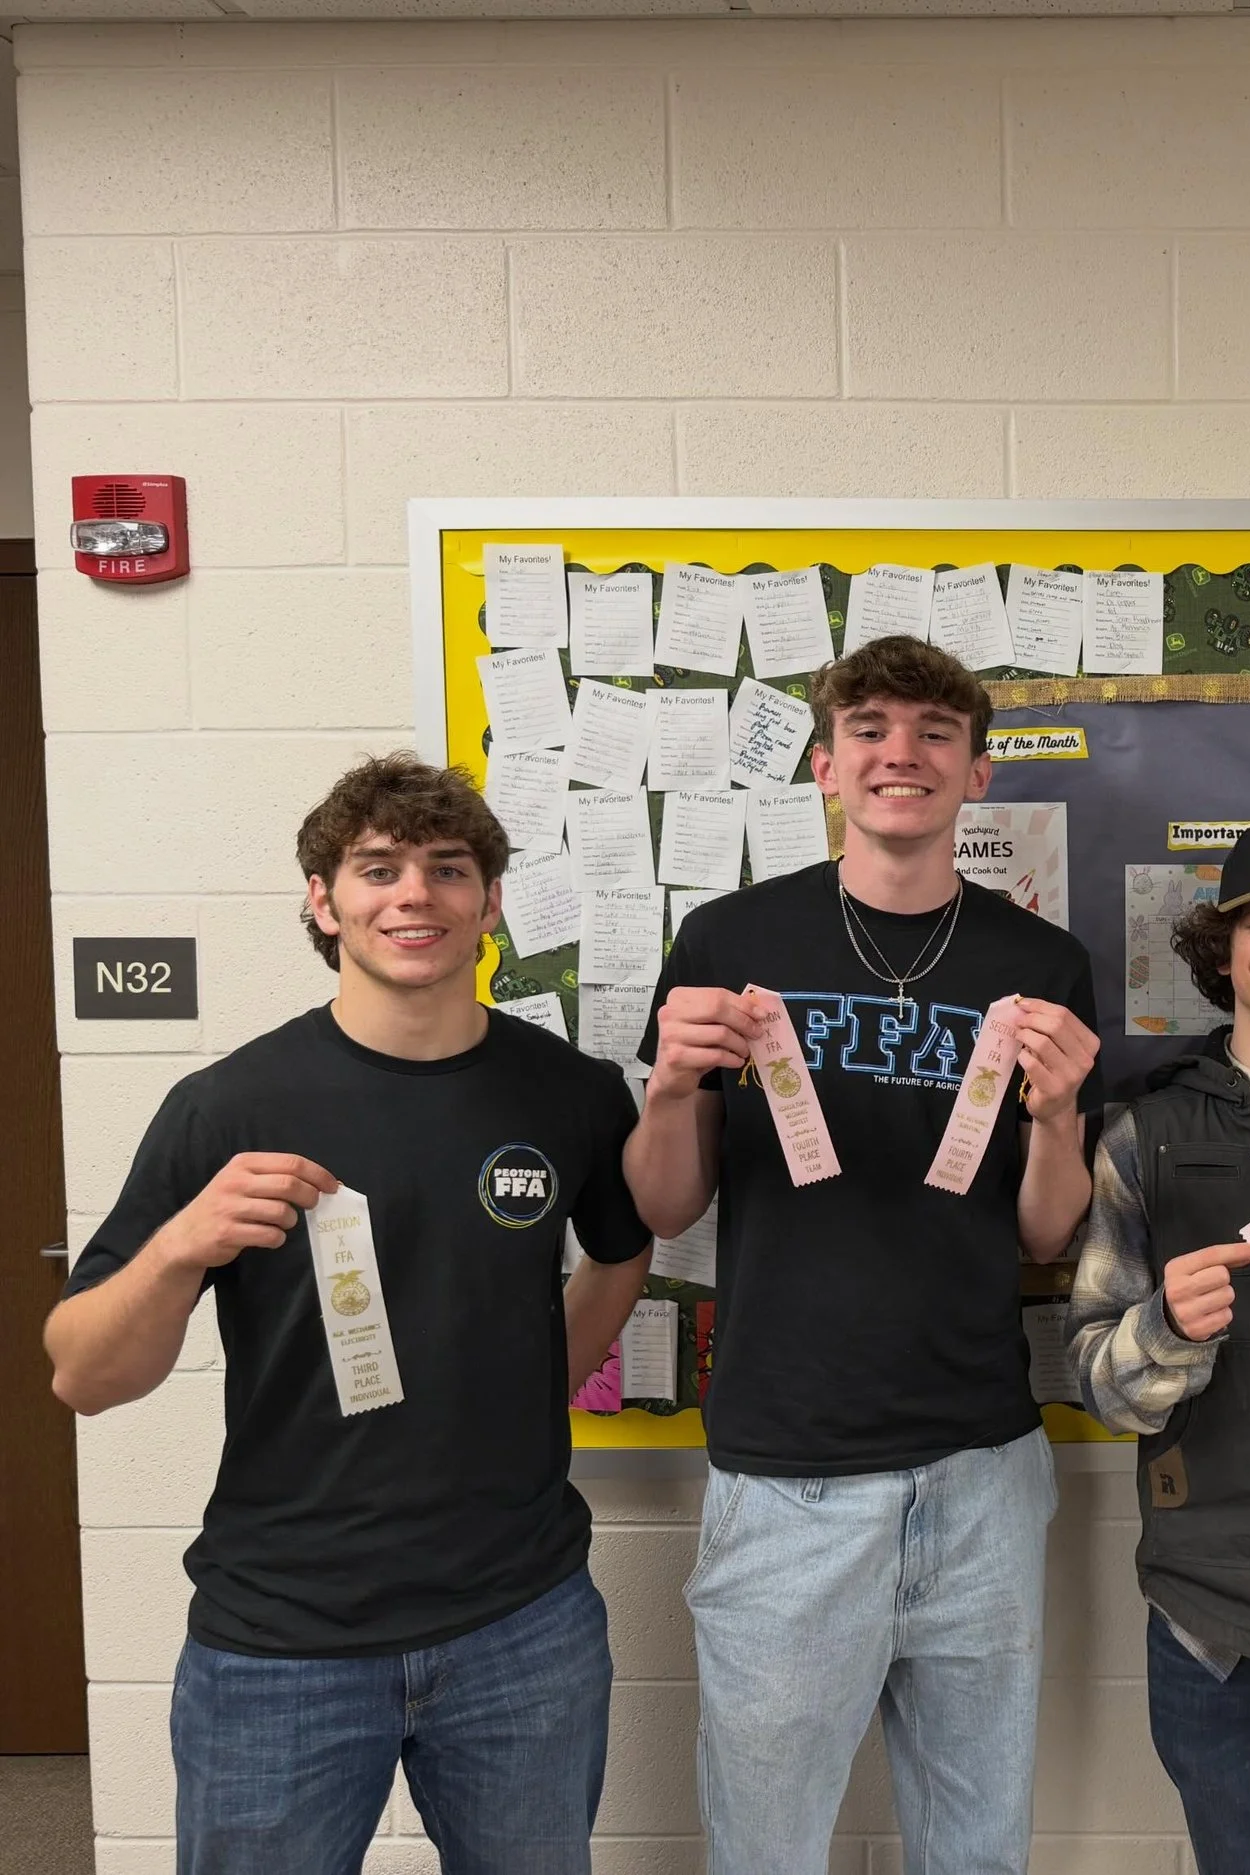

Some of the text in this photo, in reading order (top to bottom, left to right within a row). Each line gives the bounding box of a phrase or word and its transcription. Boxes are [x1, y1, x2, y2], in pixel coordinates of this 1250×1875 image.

[499, 555, 551, 565] My Favorites!
[98, 560, 147, 574] FIRE
[678, 571, 735, 588] My Favorites!
[867, 567, 923, 583] My Favorites!
[584, 584, 640, 594] My Favorites!
[752, 575, 808, 591] My Favorites!
[933, 575, 986, 593] My Favorites!
[1023, 577, 1078, 593] My Favorites!
[1096, 577, 1151, 588] My Favorites!
[491, 652, 546, 671] My Favorites!
[591, 689, 647, 710] My Favorites!
[660, 696, 715, 705] My Favorites!
[754, 688, 808, 716] My Favorites!
[997, 737, 1011, 755] of
[1013, 736, 1035, 749] the
[1037, 735, 1079, 750] Month
[578, 794, 634, 806] My Favorites!
[679, 792, 734, 805] My Favorites!
[759, 794, 812, 808] My Favorites!
[962, 826, 1000, 837] Backyard
[972, 866, 992, 875] Cook
[993, 866, 1008, 874] Out
[596, 890, 651, 900] My Favorites!
[96, 961, 172, 994] N32
[593, 985, 649, 995] My Favorites!
[509, 1000, 549, 1015] Favorites!
[764, 1029, 772, 1039] X
[780, 990, 984, 1081] FFA
[766, 1042, 783, 1054] FFA
[996, 1038, 1004, 1047] X
[987, 1051, 1002, 1064] FFA
[873, 1075, 935, 1087] THE FUTURE OF
[791, 1137, 820, 1152] FOURTH
[798, 1149, 821, 1163] PLACE
[948, 1146, 974, 1161] FOURTH
[805, 1162, 822, 1174] TEAM
[946, 1159, 967, 1173] PLACE
[493, 1168, 547, 1178] PEOTONE
[494, 1177, 546, 1198] FFA
[317, 1216, 361, 1233] SECTION
[338, 1235, 345, 1247] X
[335, 1251, 355, 1264] FFA
[633, 1309, 646, 1319] My
[352, 1362, 379, 1375] THIRD
[354, 1376, 382, 1389] PLACE
[350, 1387, 391, 1403] INDIVIDUAL
